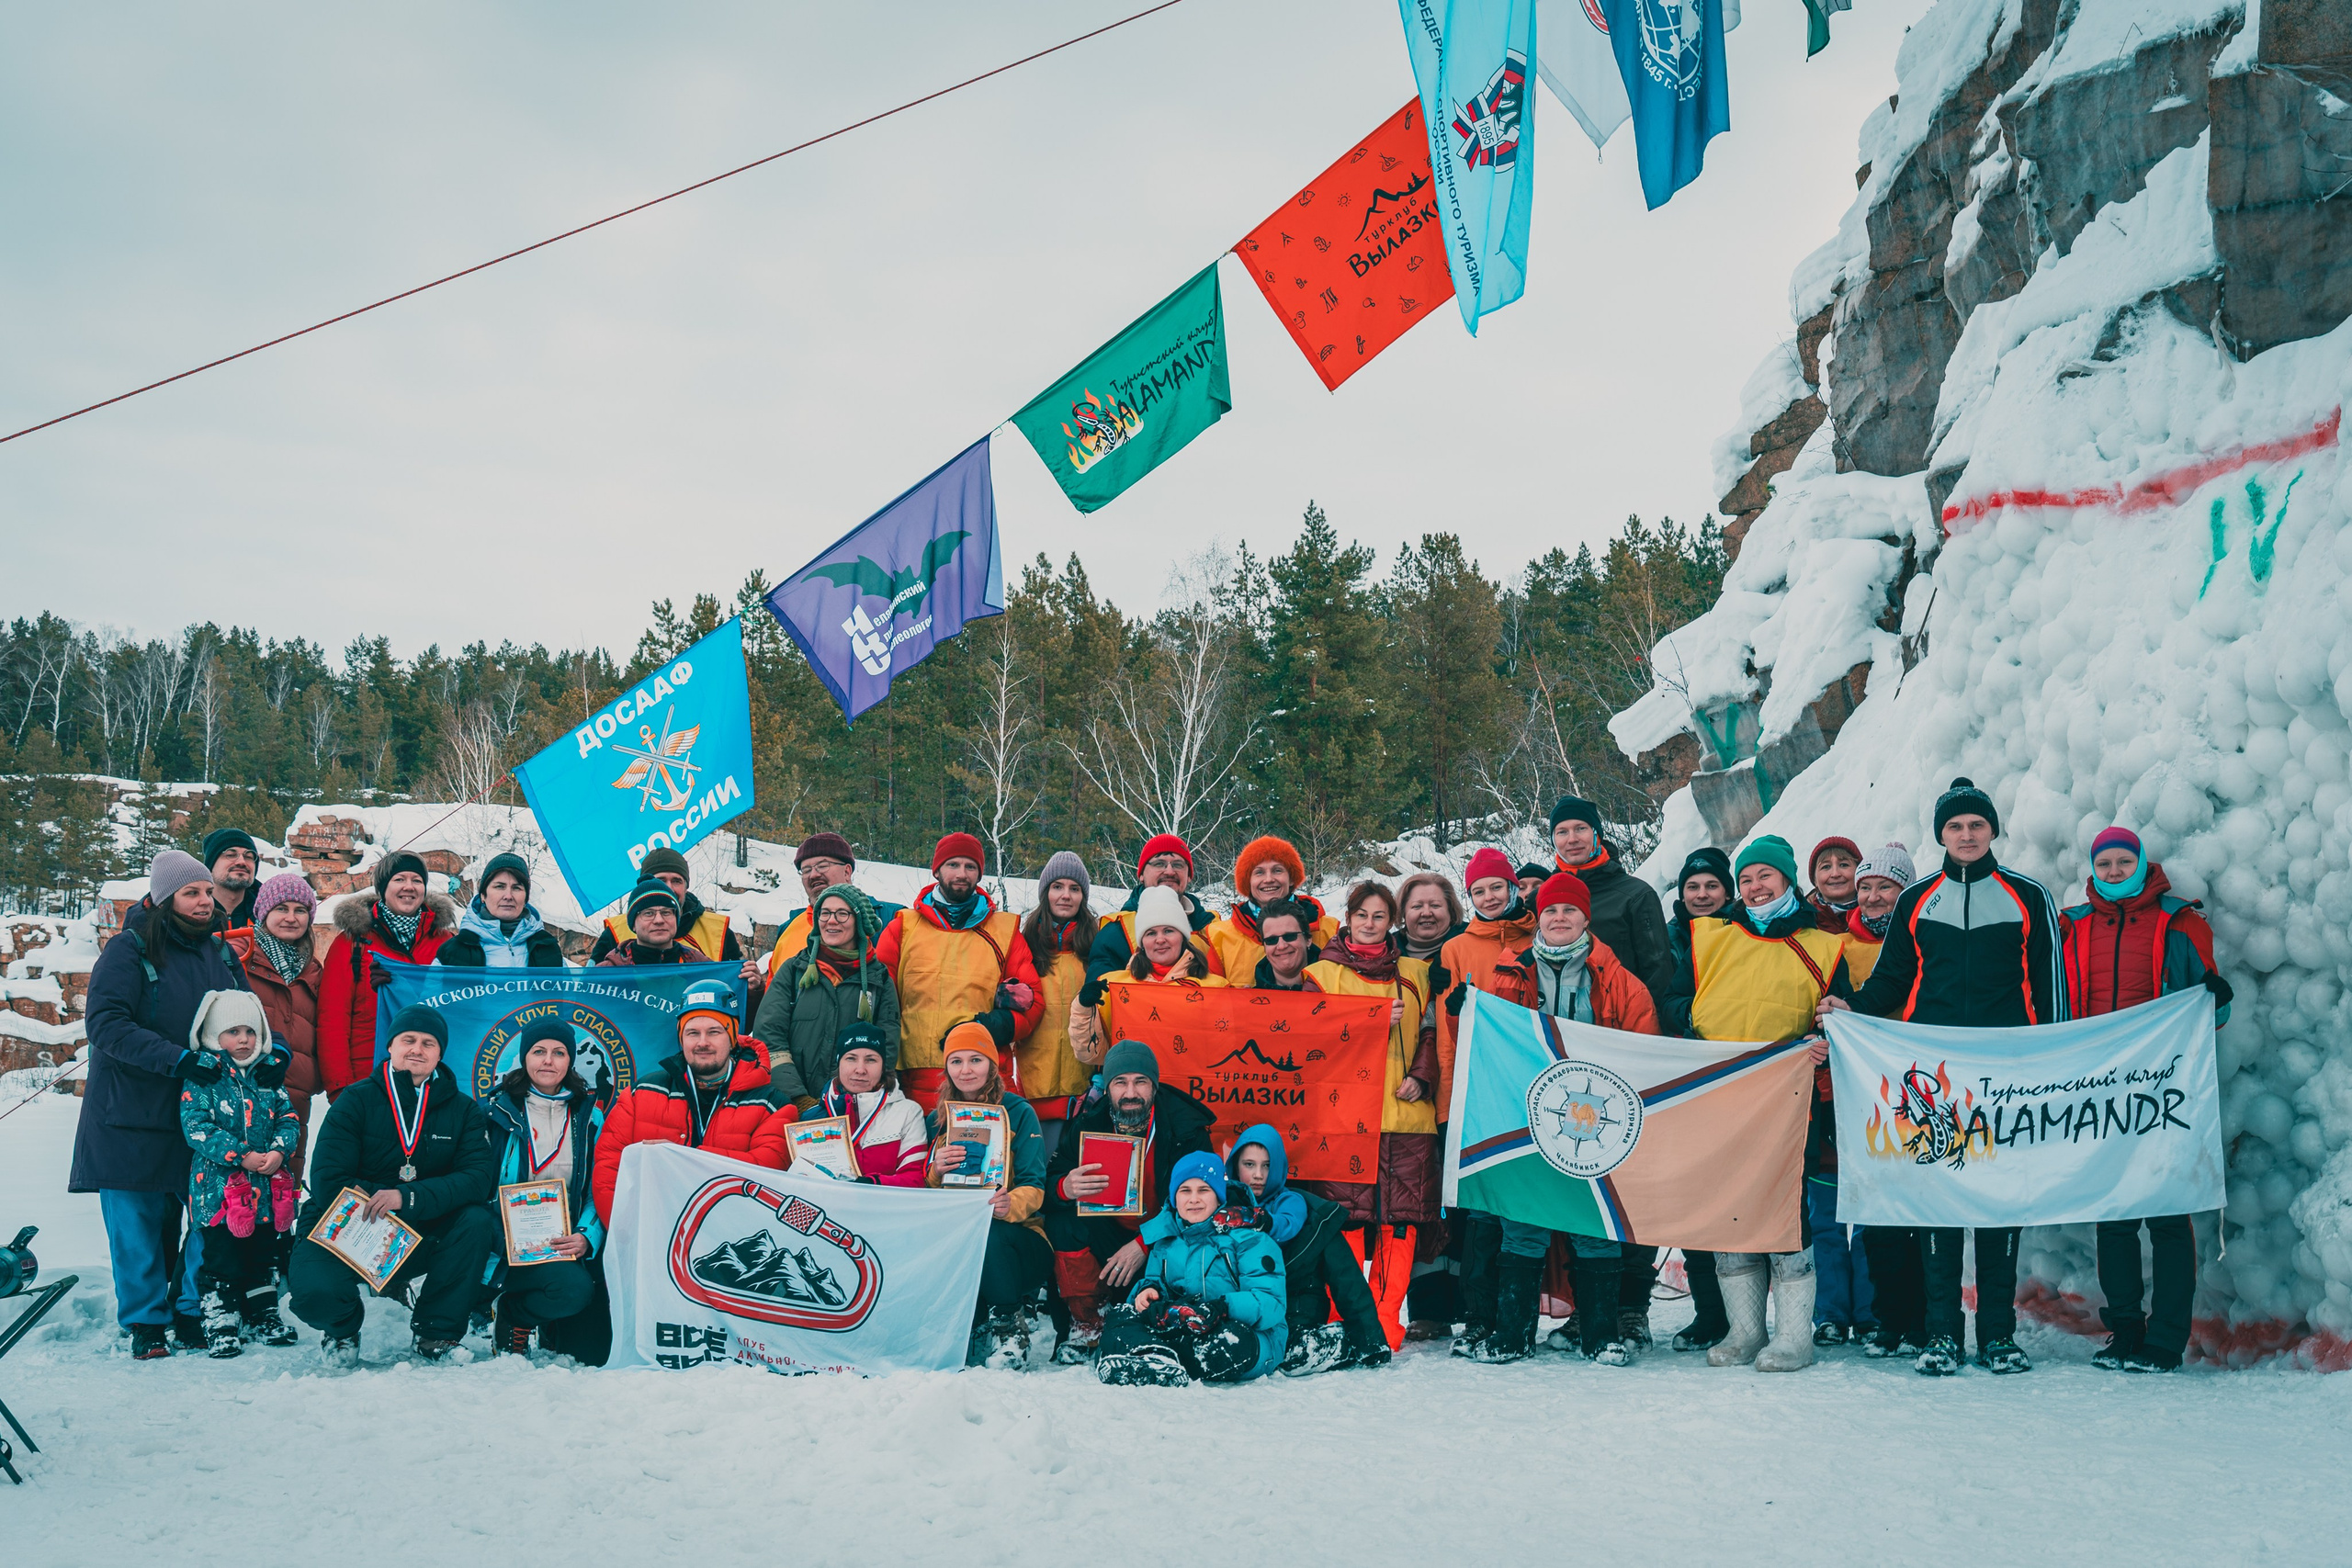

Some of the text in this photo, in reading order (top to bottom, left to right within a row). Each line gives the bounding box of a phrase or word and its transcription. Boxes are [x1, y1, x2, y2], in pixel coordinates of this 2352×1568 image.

[1641, 52, 1665, 83] 1845
[1431, 116, 1444, 186] ОССИИ
[1478, 120, 1495, 146] 1895
[1363, 196, 1417, 243] турклуб
[1438, 97, 1462, 220] СПОРТИВНОГО
[1456, 222, 1481, 297] ТУРИЗМА
[1109, 309, 1215, 395] Туристский клуб
[575, 660, 694, 760] ДОСААФ
[627, 774, 742, 872] РОССИИ
[477, 1028, 510, 1099] ГОРНЫЙ
[514, 1005, 559, 1027] КЛУБ
[1215, 1071, 1279, 1083] турклуб
[1979, 1054, 2184, 1106] Туристский клуб
[1532, 1066, 1635, 1145] Городская федерация спортивного туризма
[1556, 1152, 1600, 1170] Челябинск
[656, 1322, 728, 1355] ВСЁ
